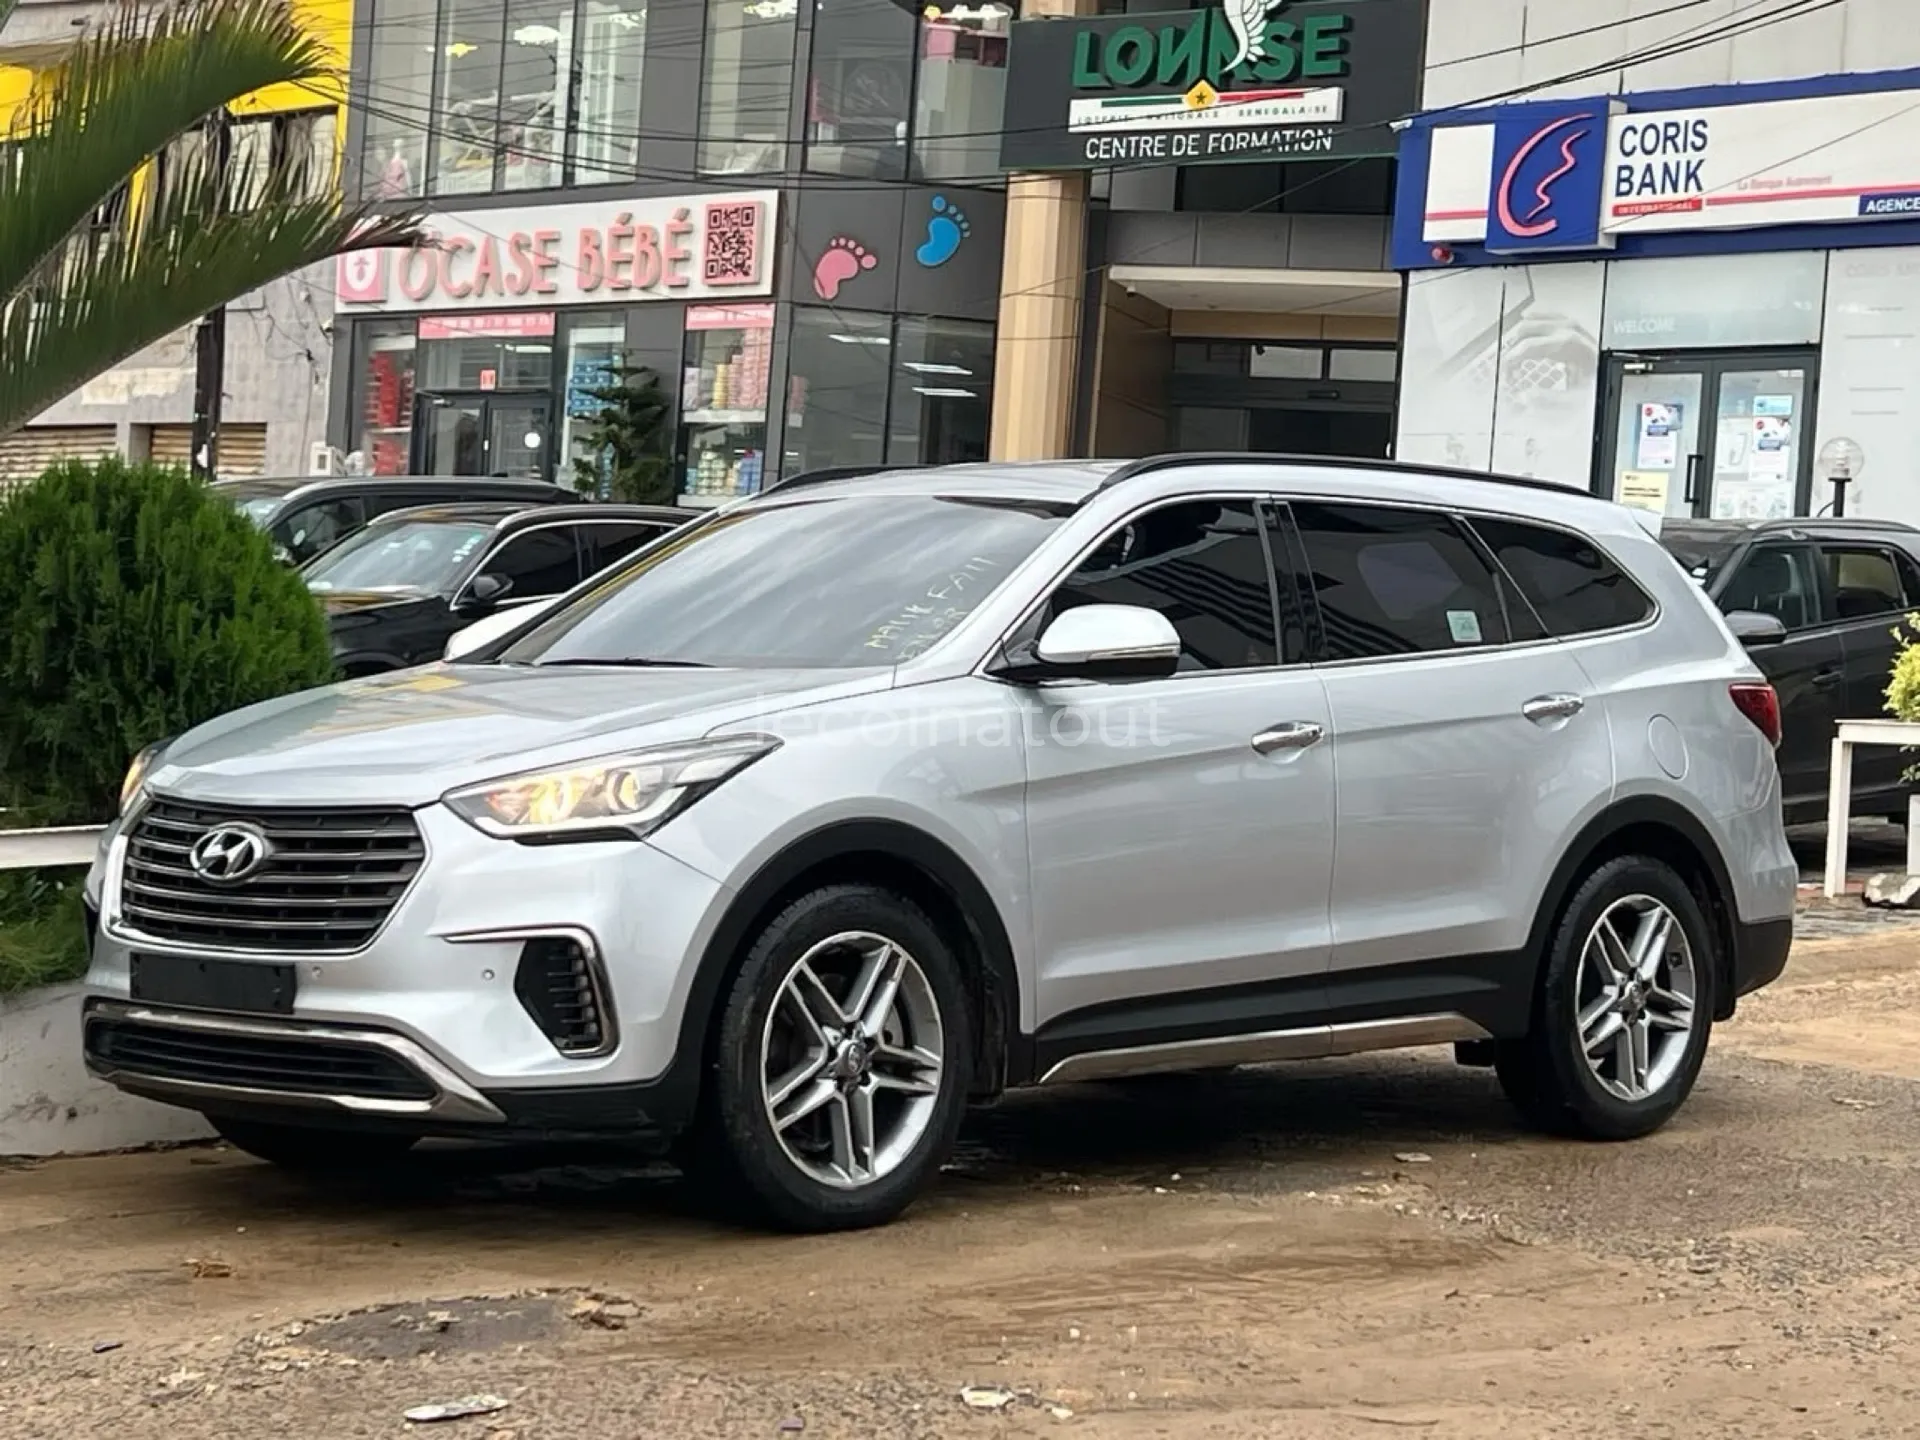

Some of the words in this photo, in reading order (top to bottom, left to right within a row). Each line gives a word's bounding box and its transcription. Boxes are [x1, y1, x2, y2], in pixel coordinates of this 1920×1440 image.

[1086, 135, 1167, 159] CENTRE
[1172, 134, 1200, 155] DE
[1207, 128, 1333, 154] FORMATION
[1619, 119, 1708, 157] CORIS
[1615, 158, 1706, 197] BANK
[1865, 196, 1920, 213] AGENCE
[577, 207, 695, 292] BÉBÉ
[1614, 316, 1676, 334] WELCOME
